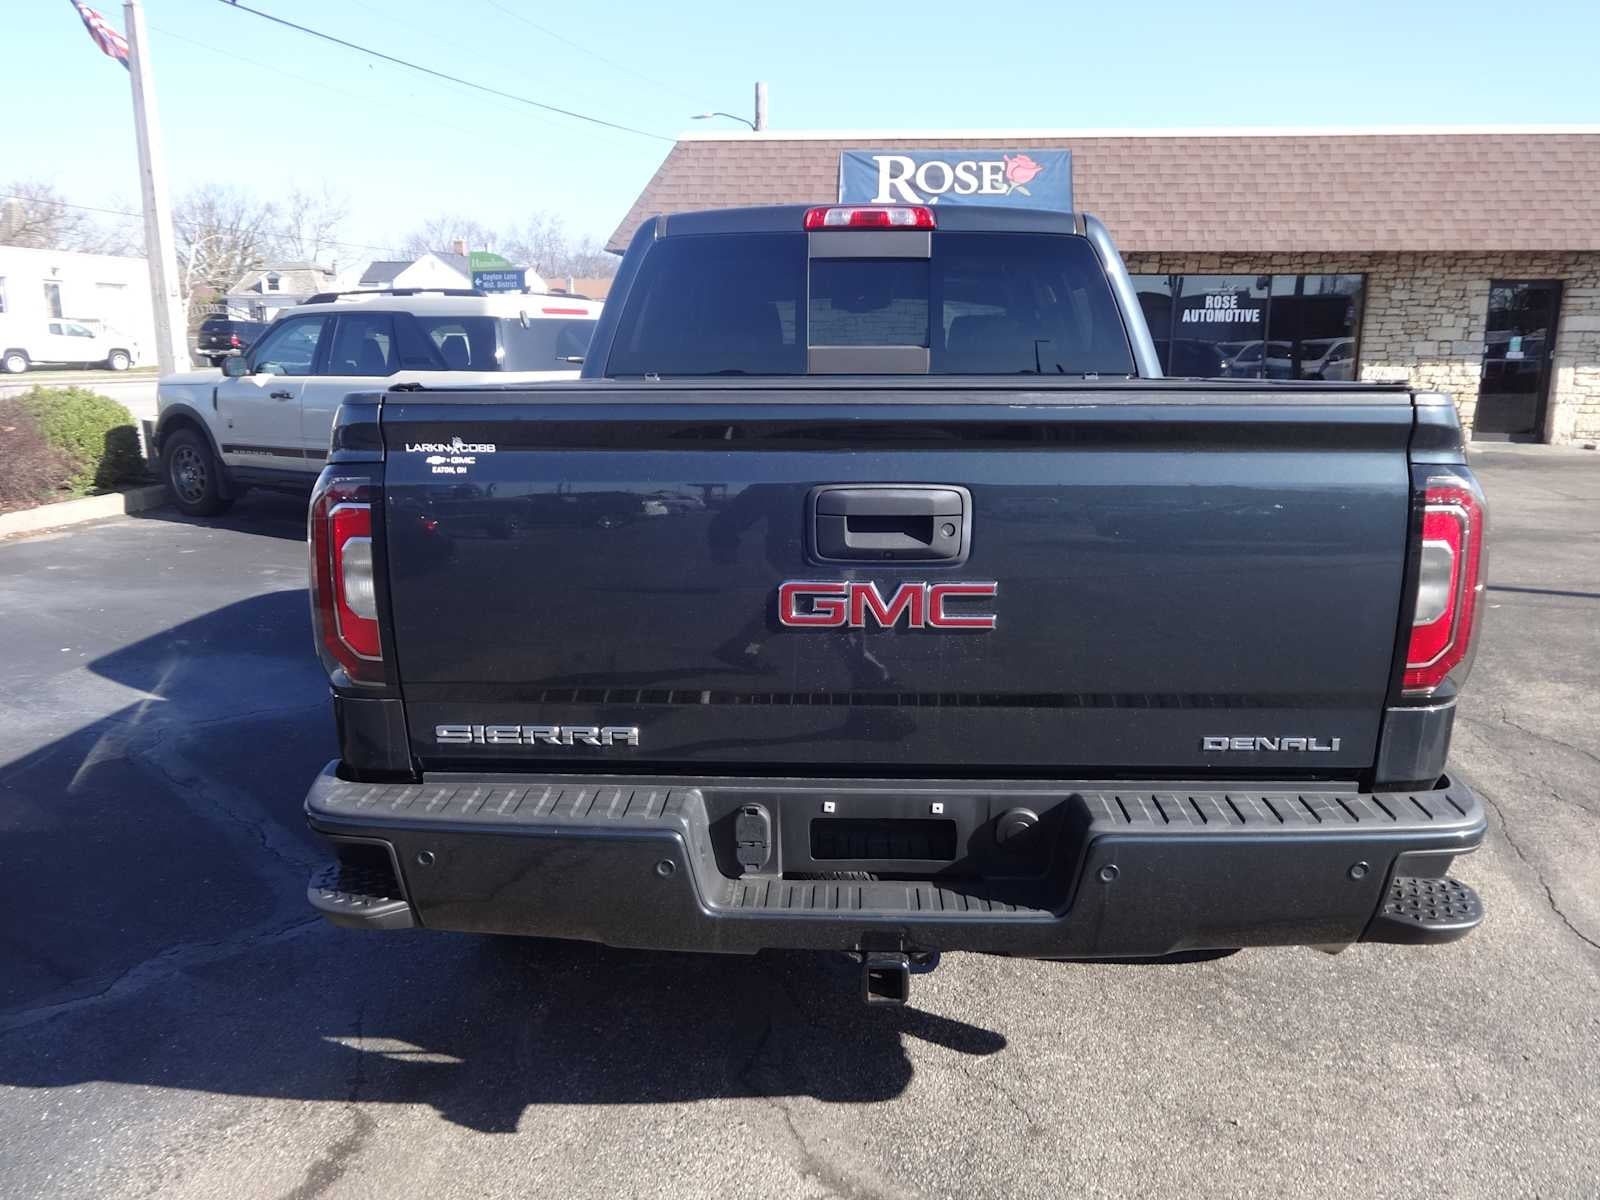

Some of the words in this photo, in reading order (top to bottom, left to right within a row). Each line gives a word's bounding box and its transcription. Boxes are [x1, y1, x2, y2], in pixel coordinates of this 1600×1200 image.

[871, 155, 1008, 204] ROSE
[1205, 295, 1238, 309] ROSE
[1182, 309, 1260, 322] AUTOMOTIVE
[405, 443, 452, 453] LARKIN
[460, 443, 496, 453] COBB
[451, 456, 476, 464] GMC
[778, 581, 998, 629] GMC
[435, 725, 639, 746] SIERRA
[1203, 736, 1341, 752] DENALI
